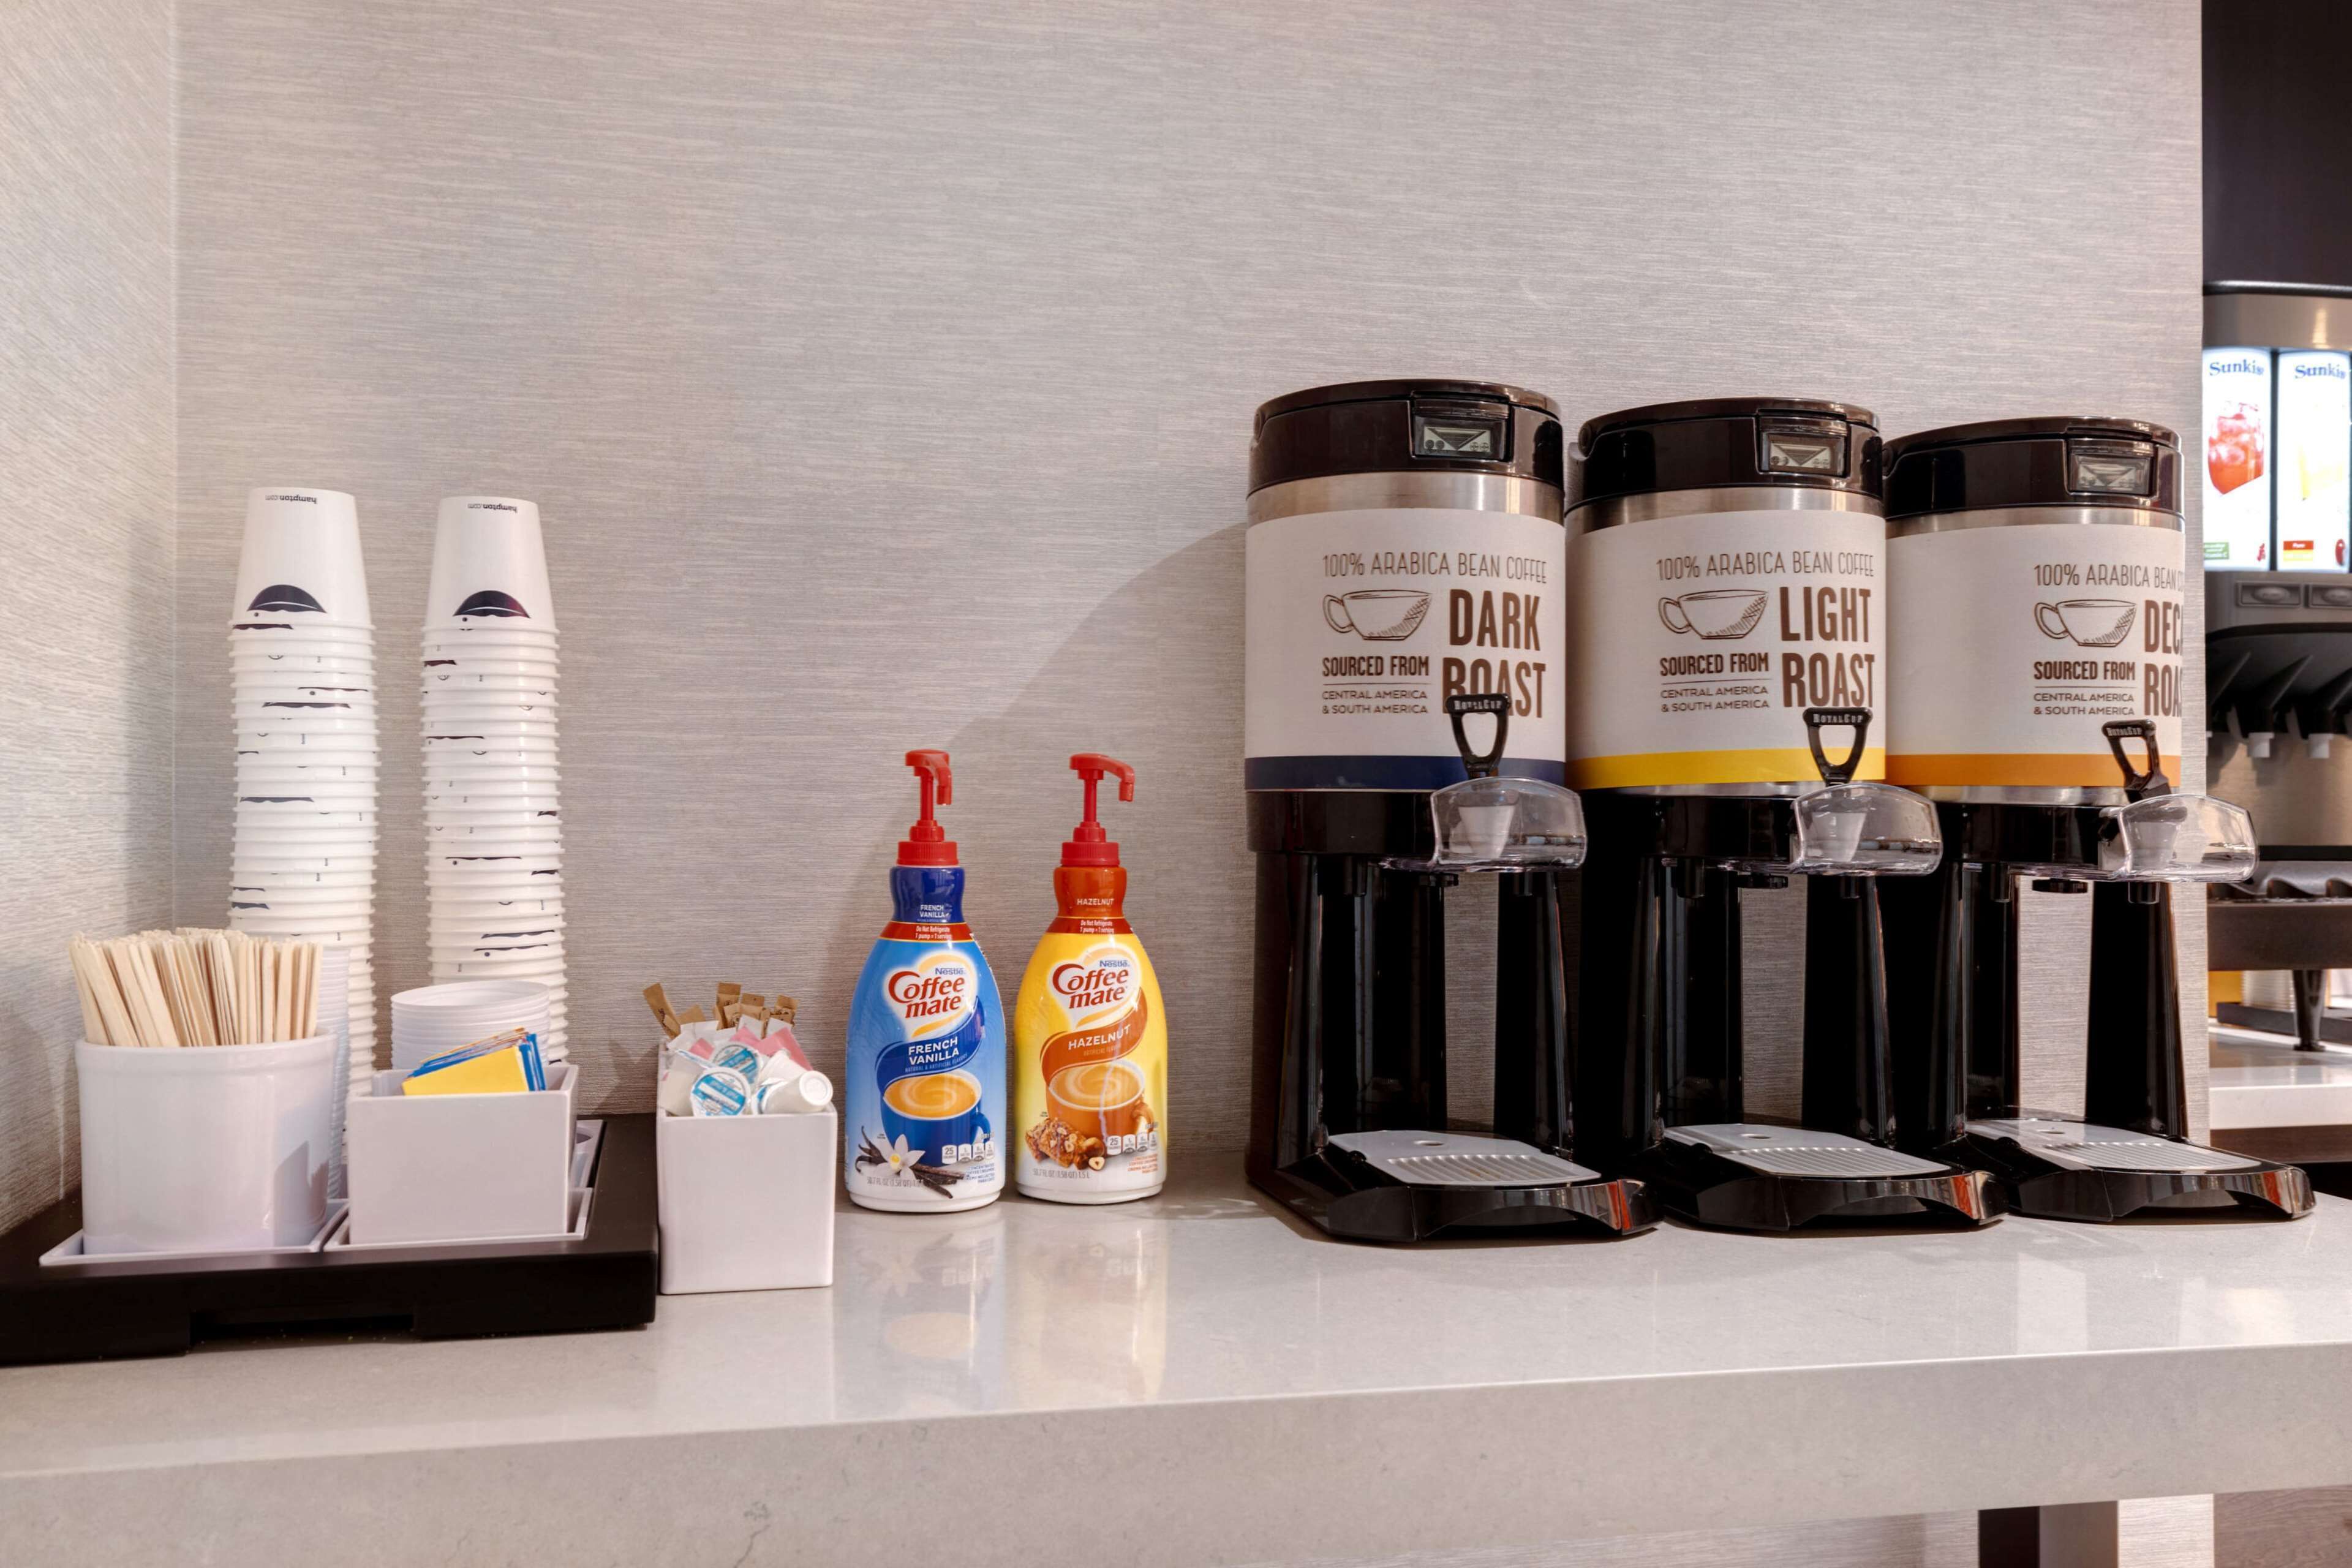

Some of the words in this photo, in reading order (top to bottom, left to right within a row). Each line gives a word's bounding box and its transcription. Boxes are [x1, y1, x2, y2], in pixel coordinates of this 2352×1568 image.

[1322, 552, 1366, 577] 100%
[1371, 552, 1451, 575] ARABICA
[1458, 552, 1500, 578] BEAN
[1506, 556, 1547, 584] COFFEE
[1656, 556, 1701, 581] 100%
[1706, 551, 1786, 576] ARABICA
[1793, 551, 1833, 574] BEAN
[1838, 552, 1874, 577] COFFEE
[2034, 564, 2080, 586] 100%
[2085, 564, 2150, 587] ARABICA
[2154, 566, 2176, 591] BEAN
[1450, 589, 1540, 651] DARK
[1779, 586, 1871, 643] LIGHT
[2144, 599, 2183, 656] DEC
[1322, 655, 1384, 677] SOURCED
[1390, 655, 1430, 676] FROM
[1659, 654, 1724, 677] SOURCED
[1730, 652, 1769, 673] FROM
[2033, 660, 2098, 680] SOURCED
[2103, 661, 2136, 680] FROM
[1442, 657, 1547, 718] ROAST
[1782, 652, 1875, 707] ROAST
[2144, 663, 2182, 717] ROA
[1322, 690, 1373, 700] CENTRAL
[1374, 690, 1428, 699] AMERICA
[1660, 688, 1713, 699] CENTRAL
[1715, 685, 1769, 696] AMERICA
[2033, 693, 2087, 702] CENTRAL
[2089, 693, 2135, 702] AMERICA
[1322, 705, 1329, 714] &
[1332, 704, 1371, 714] SOUTH
[1374, 704, 1428, 714] AMERICA
[1660, 704, 1669, 712] &
[1672, 701, 1712, 712] SOUTH
[1714, 699, 1770, 710] AMERICA
[2033, 706, 2042, 715] &
[2045, 706, 2086, 715] SOUTH
[2088, 706, 2135, 715] AMERICA
[888, 971, 965, 1003] Coffee
[1052, 963, 1129, 995] Coffee
[905, 995, 962, 1019] mate
[1068, 986, 1126, 1009] mate
[908, 1036, 959, 1056] FRENCH
[1068, 1023, 1131, 1050] HAZELNUT
[909, 1047, 960, 1065] VANILLA
[1109, 1137, 1118, 1146] 25
